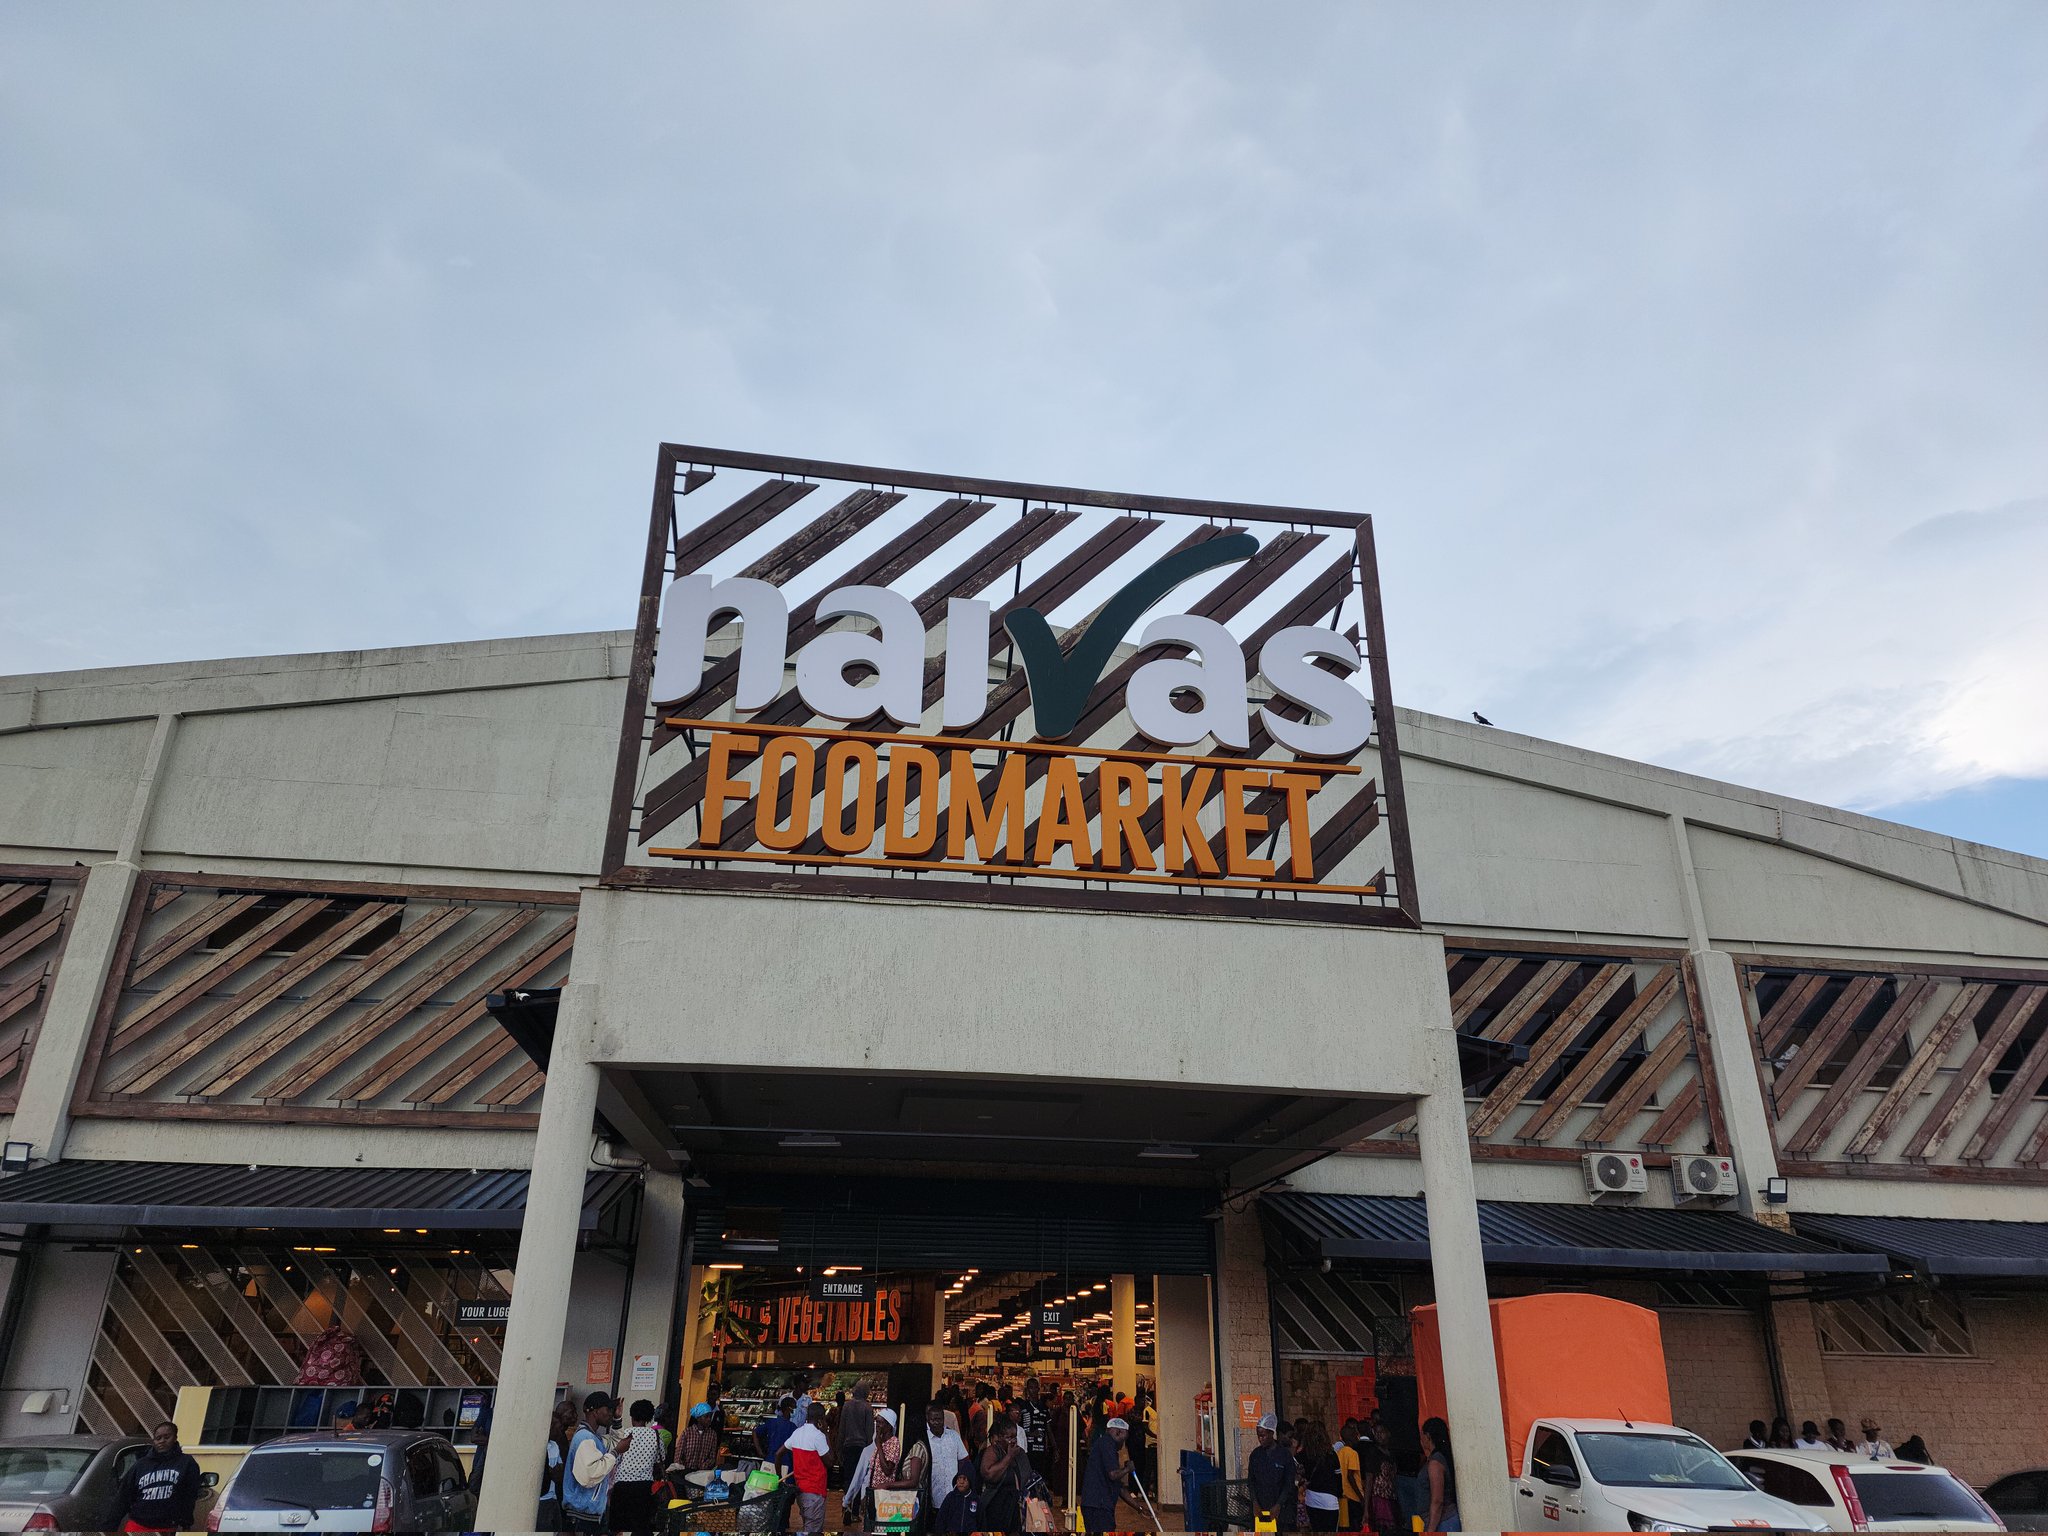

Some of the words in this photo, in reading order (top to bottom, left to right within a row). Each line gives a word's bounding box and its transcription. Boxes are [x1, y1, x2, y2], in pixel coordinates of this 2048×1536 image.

[652, 532, 1374, 758] naivas
[699, 732, 1322, 882] FOODMARKET
[822, 1283, 863, 1294] ENTRANCE
[461, 1306, 485, 1318] YOUR
[777, 1289, 900, 1344] VEGETABLES
[1043, 1311, 1060, 1322] EXIT
[1066, 1344, 1077, 1357] 20
[139, 1469, 179, 1489] SHAWNEE
[142, 1485, 173, 1500] TENNIS
